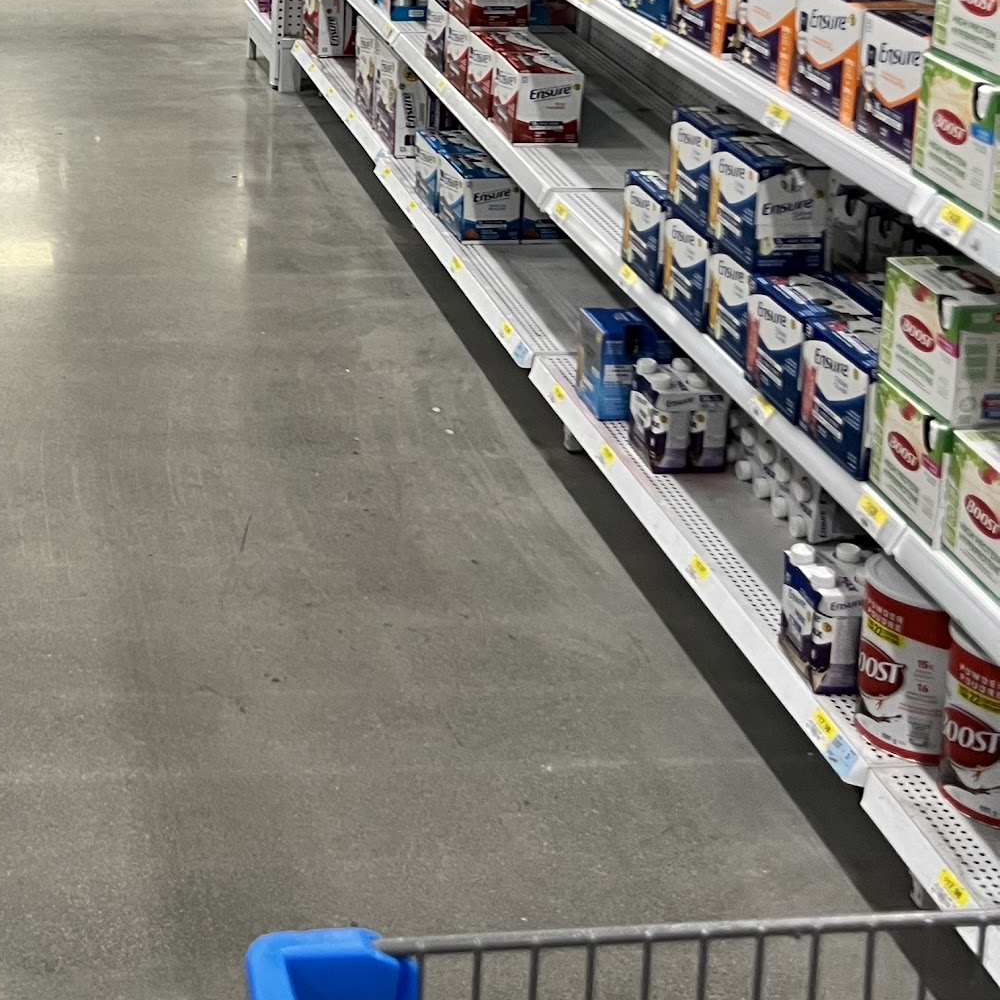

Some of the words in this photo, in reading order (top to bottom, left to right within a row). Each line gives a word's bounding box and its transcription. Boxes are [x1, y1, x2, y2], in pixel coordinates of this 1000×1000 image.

[809, 9, 848, 31] Ensure
[877, 42, 921, 67] Ensure
[529, 86, 572, 100] Ensure
[403, 92, 417, 129] Ensure
[677, 128, 702, 147] Ensure
[934, 111, 967, 140] BOOST
[719, 158, 746, 180] Ensure
[473, 189, 511, 203] Ensure
[630, 192, 651, 211] Ensure
[761, 198, 814, 216] Ensure
[671, 225, 695, 245] Ensure
[718, 259, 745, 284] Ensure
[757, 301, 787, 328] Ensure
[900, 317, 934, 348] BOOST
[814, 347, 849, 377] Ensure
[888, 435, 919, 467] BOOST
[966, 499, 1000, 535] BOOST
[830, 600, 863, 611] Ensur
[858, 651, 906, 685] OOST
